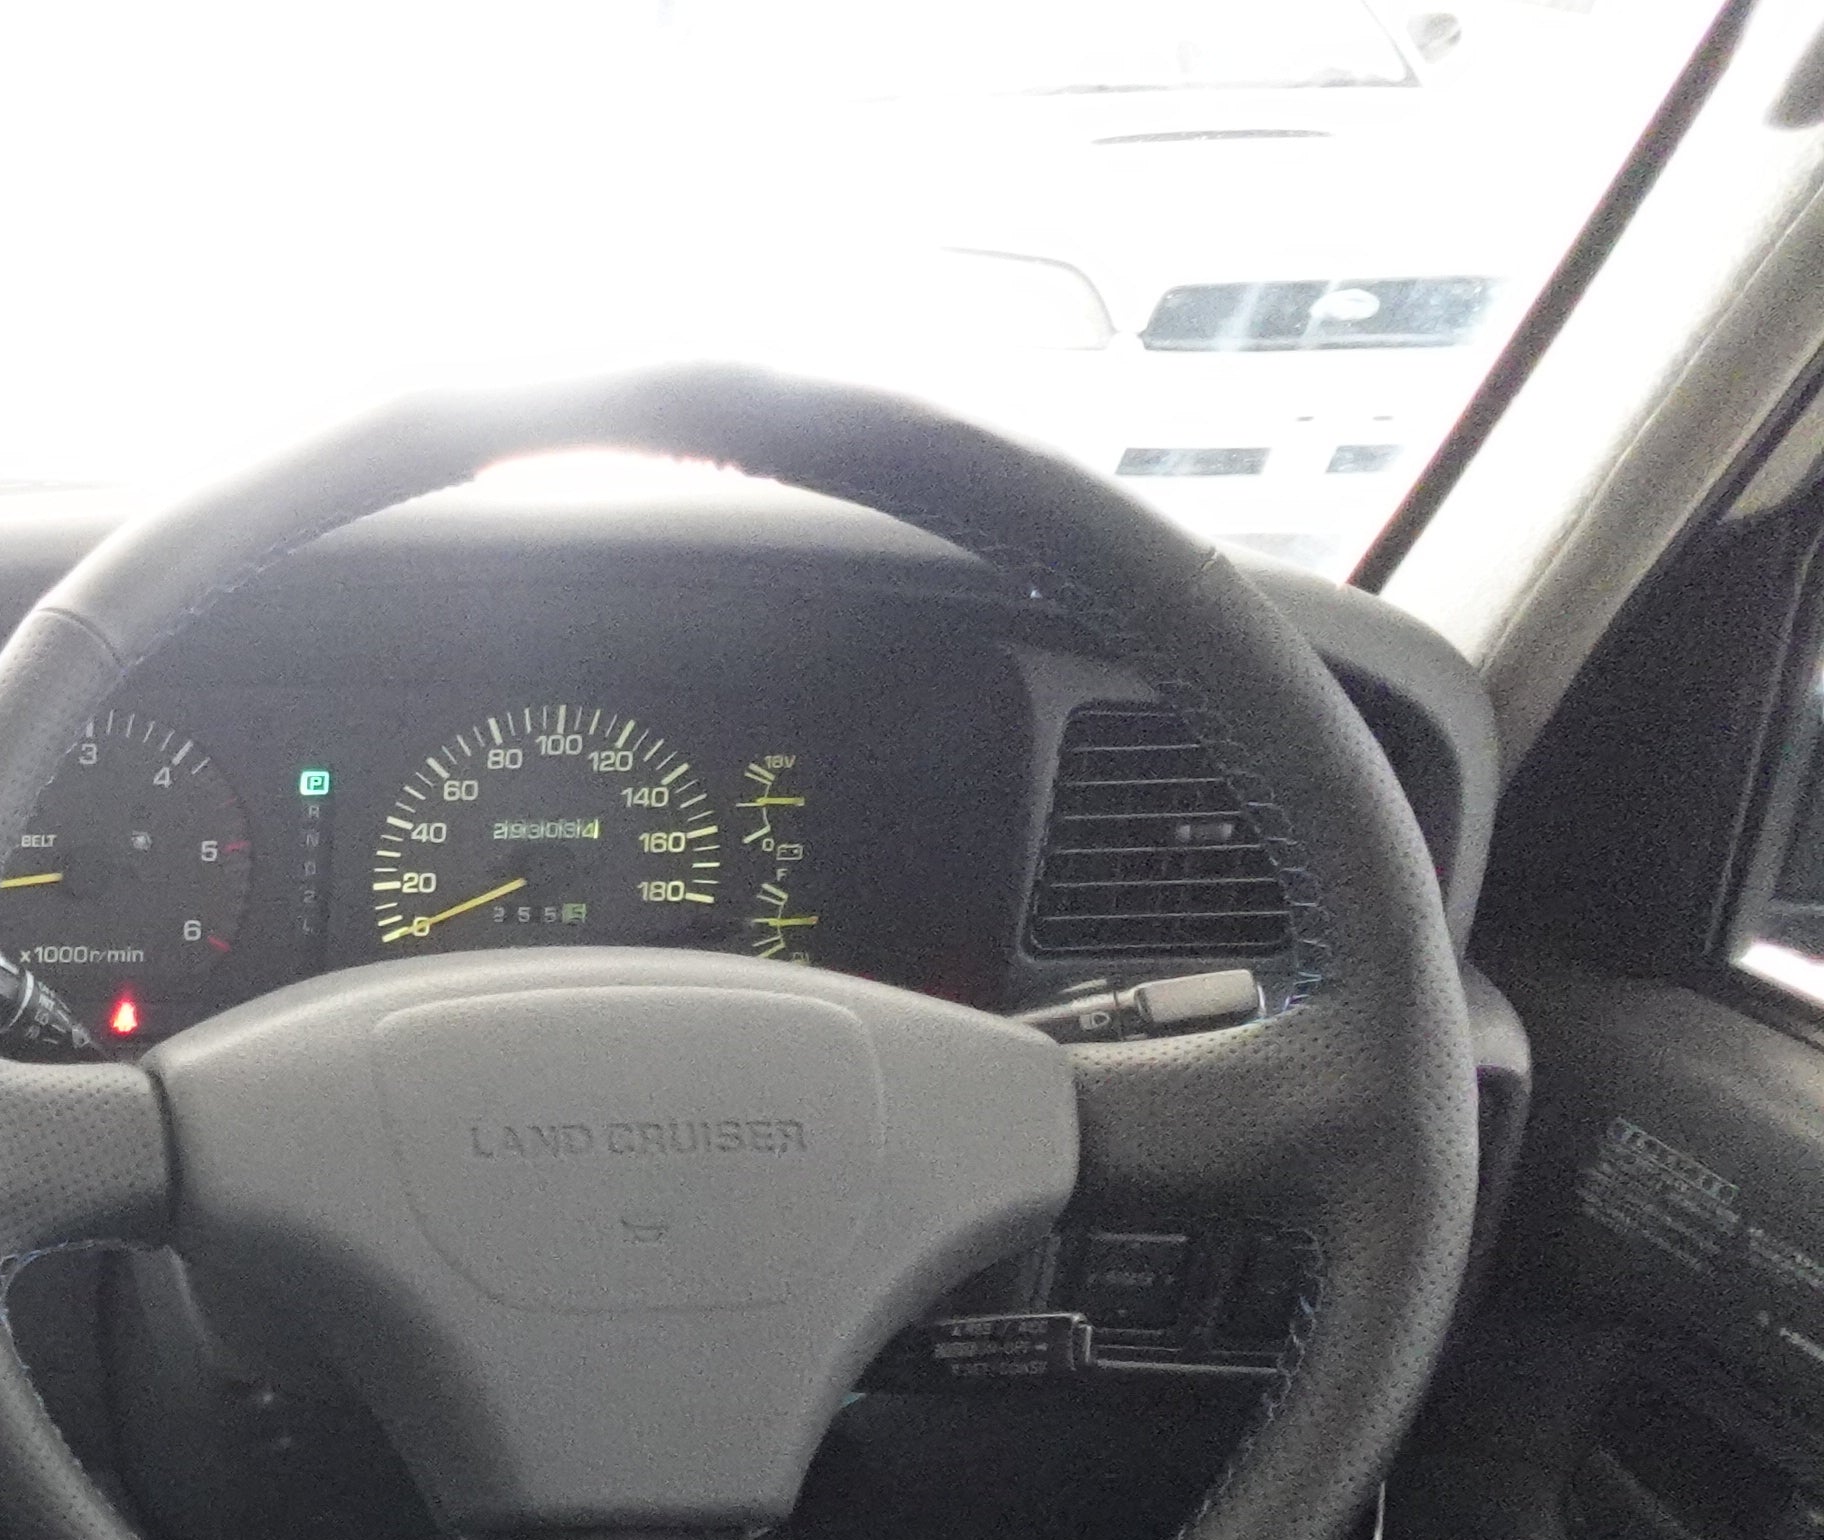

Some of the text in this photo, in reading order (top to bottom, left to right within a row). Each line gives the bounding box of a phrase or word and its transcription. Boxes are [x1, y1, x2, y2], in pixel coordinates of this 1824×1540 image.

[79, 743, 97, 765] 3
[536, 735, 583, 755] 100
[488, 749, 523, 769] 80
[588, 751, 633, 771] 120
[765, 755, 796, 769] 18V
[153, 766, 172, 788] 4
[310, 776, 323, 790] P
[443, 780, 479, 801] 60
[621, 787, 669, 808] 140
[21, 834, 57, 848] BELT
[411, 822, 447, 843] 40
[638, 832, 685, 852] 160
[201, 840, 218, 862] 5
[402, 872, 437, 893] 20
[777, 868, 789, 881] F
[637, 881, 685, 901] 180
[183, 920, 202, 941] 6
[412, 916, 430, 936] 0
[470, 1119, 806, 1159] LAND CRUISER
